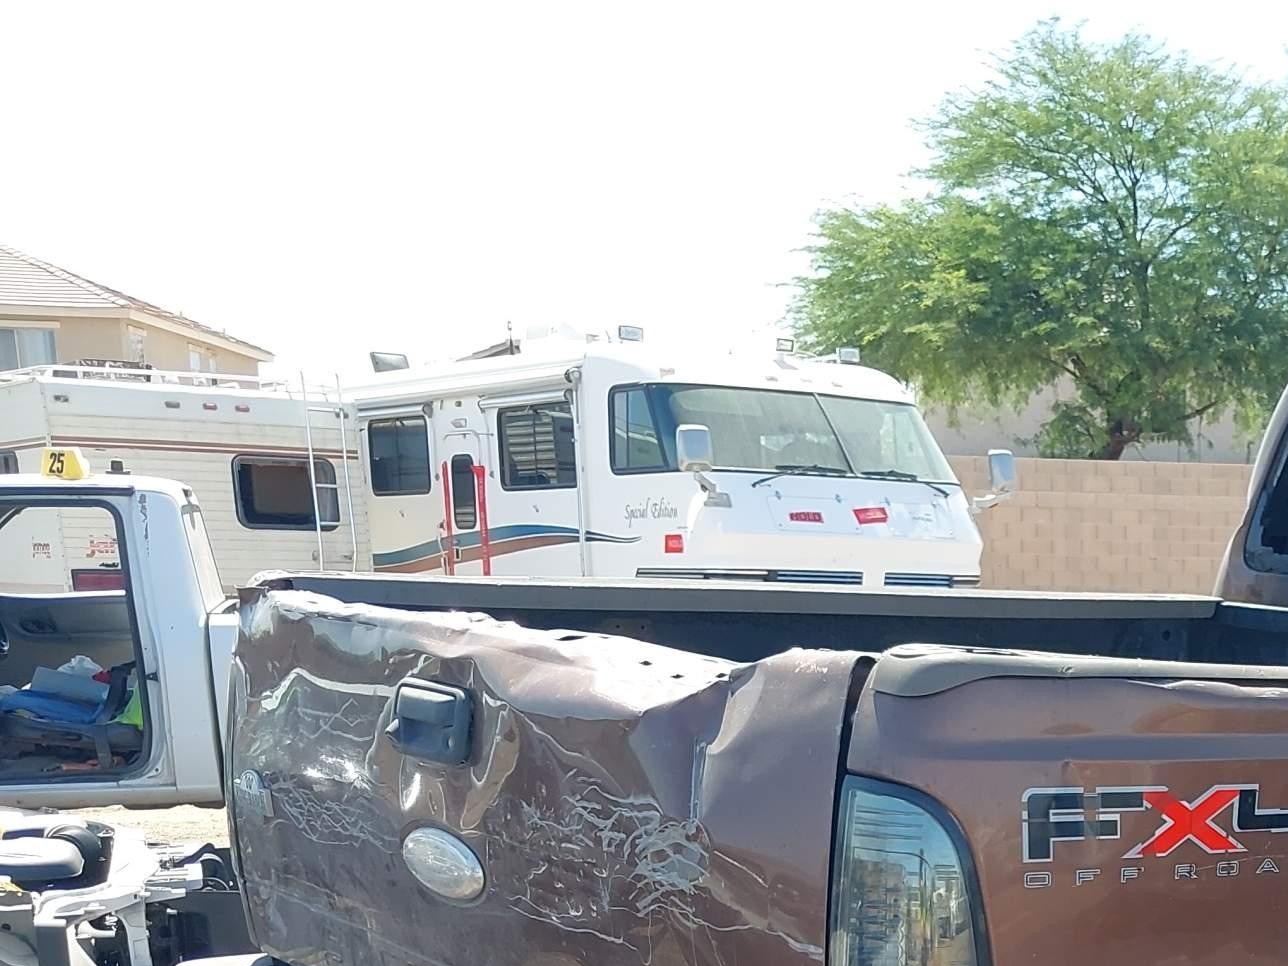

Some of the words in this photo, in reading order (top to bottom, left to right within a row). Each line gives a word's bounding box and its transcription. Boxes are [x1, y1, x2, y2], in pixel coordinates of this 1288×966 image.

[49, 452, 65, 474] 25
[624, 497, 651, 529] Special
[650, 497, 678, 519] Edition
